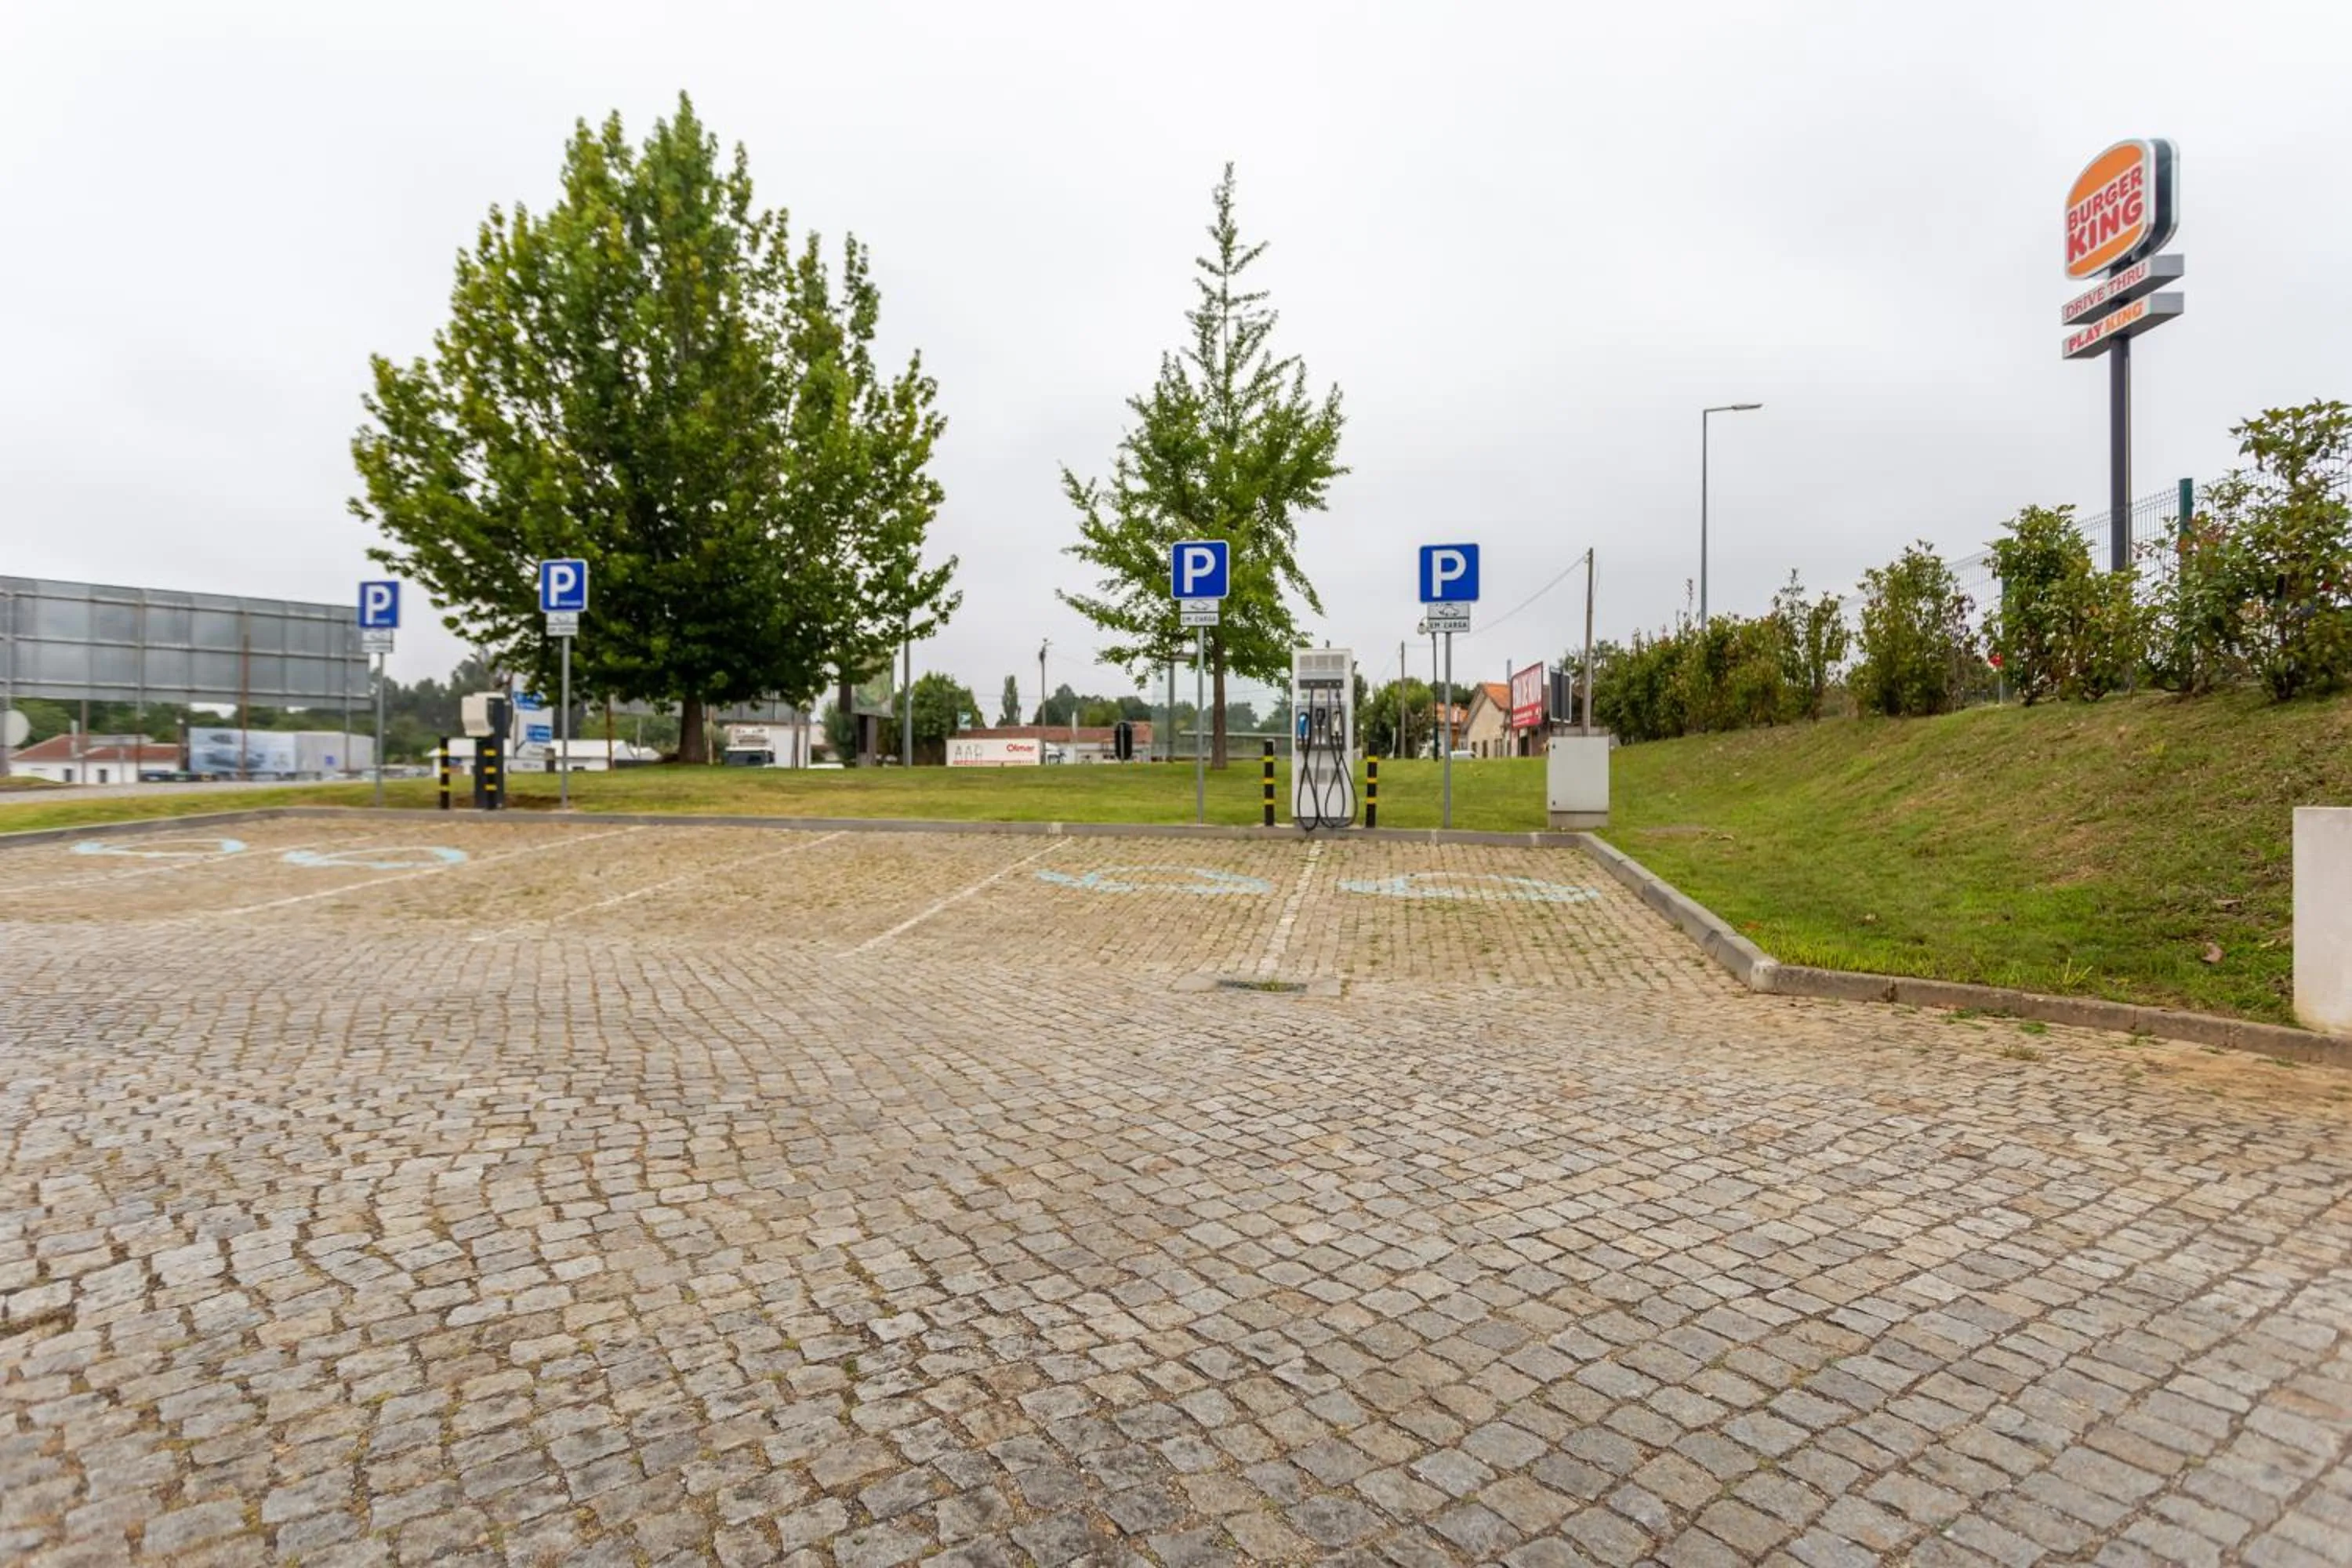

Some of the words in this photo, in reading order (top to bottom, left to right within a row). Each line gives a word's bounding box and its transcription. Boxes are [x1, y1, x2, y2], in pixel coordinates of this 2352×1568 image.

[2067, 165, 2143, 232] BURGER
[2067, 190, 2143, 263] KING
[2065, 286, 2106, 321] DRIVE
[2107, 262, 2146, 296] THRU
[2068, 322, 2104, 352] PLAY
[2104, 300, 2143, 333] KING
[550, 565, 576, 607] P
[1184, 547, 1216, 593] P
[1432, 550, 1467, 597] P
[365, 585, 391, 625] P
